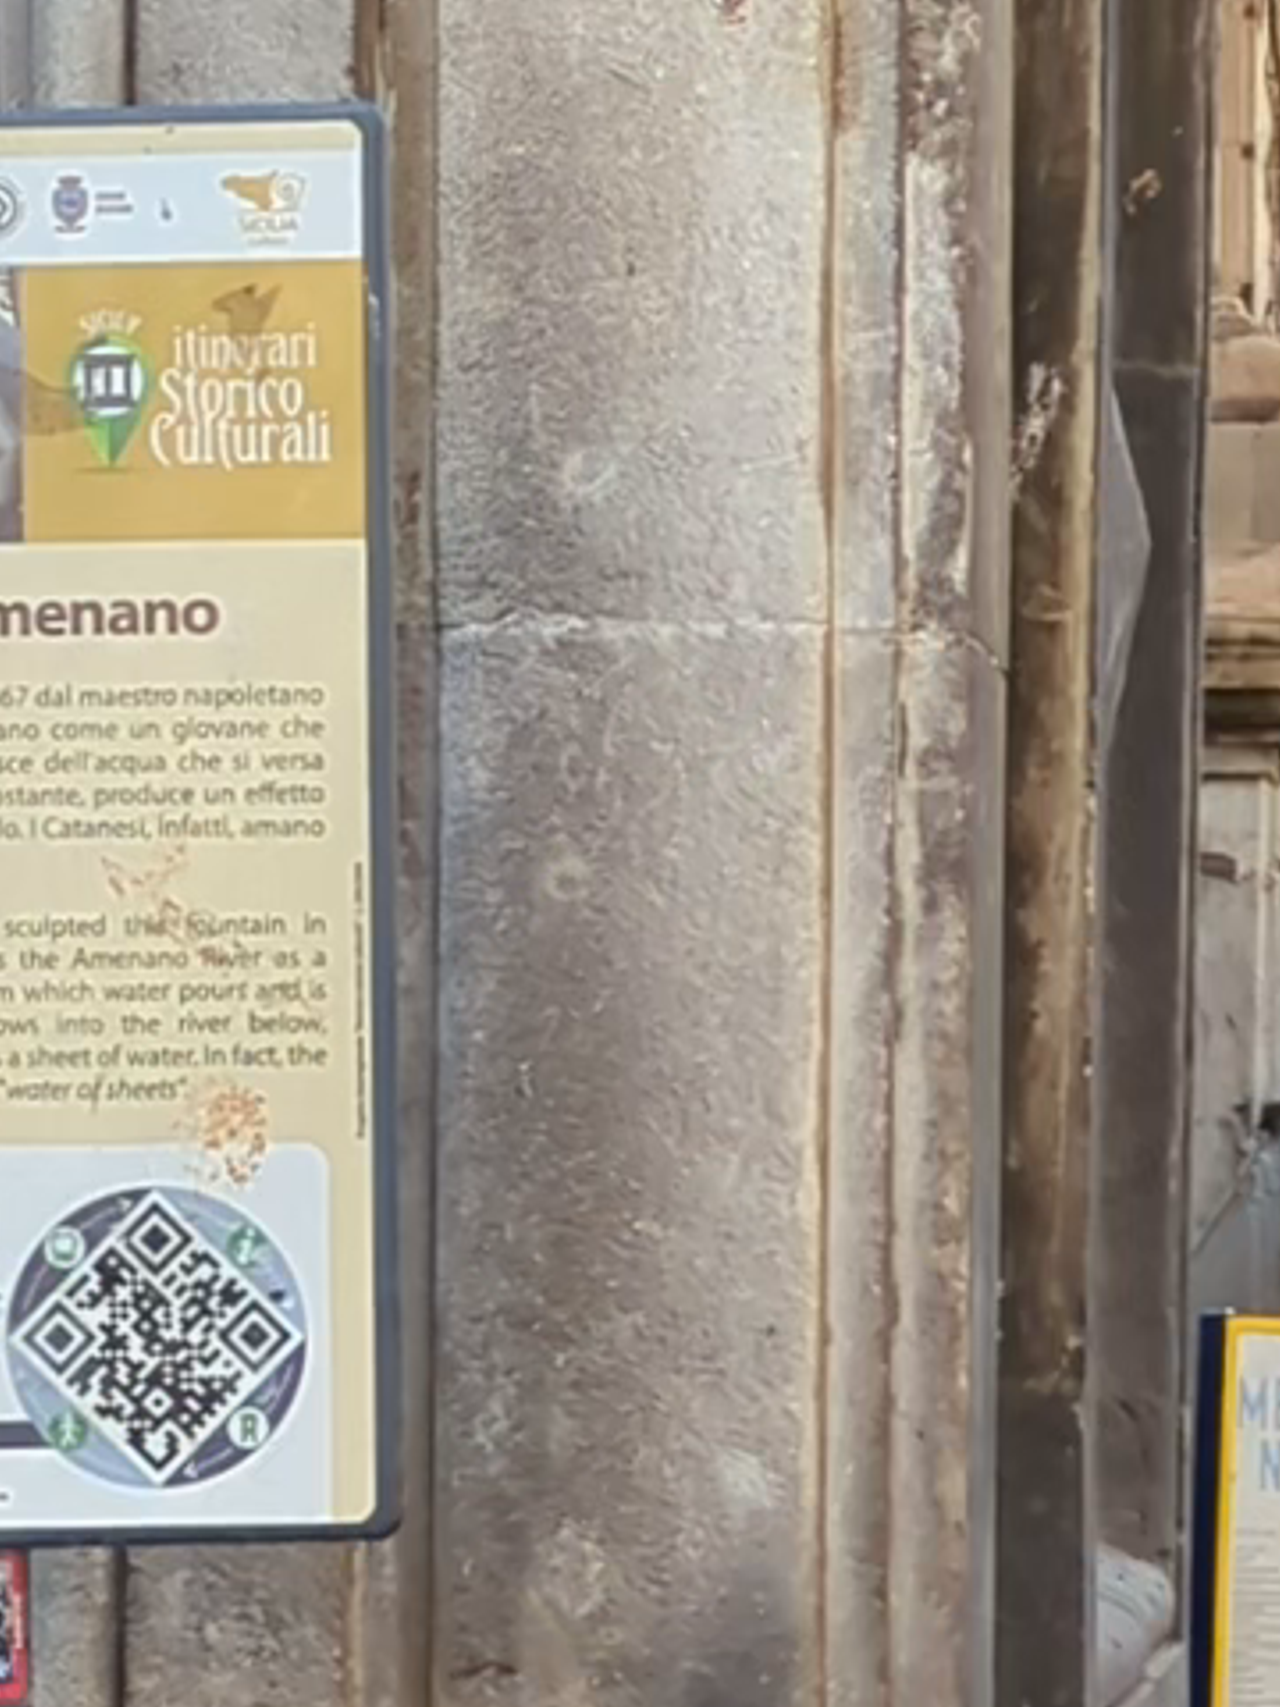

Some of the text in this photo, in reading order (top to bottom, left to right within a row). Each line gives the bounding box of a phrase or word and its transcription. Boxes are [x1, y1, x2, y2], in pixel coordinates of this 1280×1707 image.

[159, 366, 305, 423] Storico
[148, 408, 332, 471] Culturali
[33, 686, 73, 709] dal
[78, 686, 177, 708] maestro
[183, 682, 324, 713] napoletano
[49, 724, 118, 742] come
[129, 724, 160, 741] un
[171, 717, 269, 747] giovane
[278, 716, 325, 739] che
[43, 749, 167, 780] dell'acqua
[176, 748, 223, 772] che
[233, 748, 252, 771] si
[260, 753, 324, 771] versa
[93, 782, 194, 812] produce
[204, 787, 235, 805] un
[243, 780, 324, 804] effetto
[30, 817, 37, 840] I
[41, 815, 152, 844] Catanesi,
[157, 814, 235, 842] infatti,
[239, 819, 326, 837] amano
[3, 914, 107, 944] sculpted
[304, 912, 327, 935] in
[19, 947, 60, 971] the
[71, 946, 189, 970] Amenano
[272, 951, 300, 968] as
[311, 951, 327, 968] a
[21, 980, 93, 1004] which
[102, 982, 171, 1003] water
[179, 985, 247, 1008] pours
[310, 978, 327, 1001] is
[55, 1012, 105, 1035] into
[121, 1011, 160, 1035] the
[178, 1011, 232, 1034] river
[7, 1052, 21, 1069] a
[25, 1045, 92, 1069] sheet
[97, 1045, 122, 1068] of
[126, 1046, 198, 1068] water.
[203, 1044, 226, 1067] In
[231, 1043, 284, 1071] fact,
[288, 1043, 328, 1066] the
[75, 1075, 103, 1113] of
